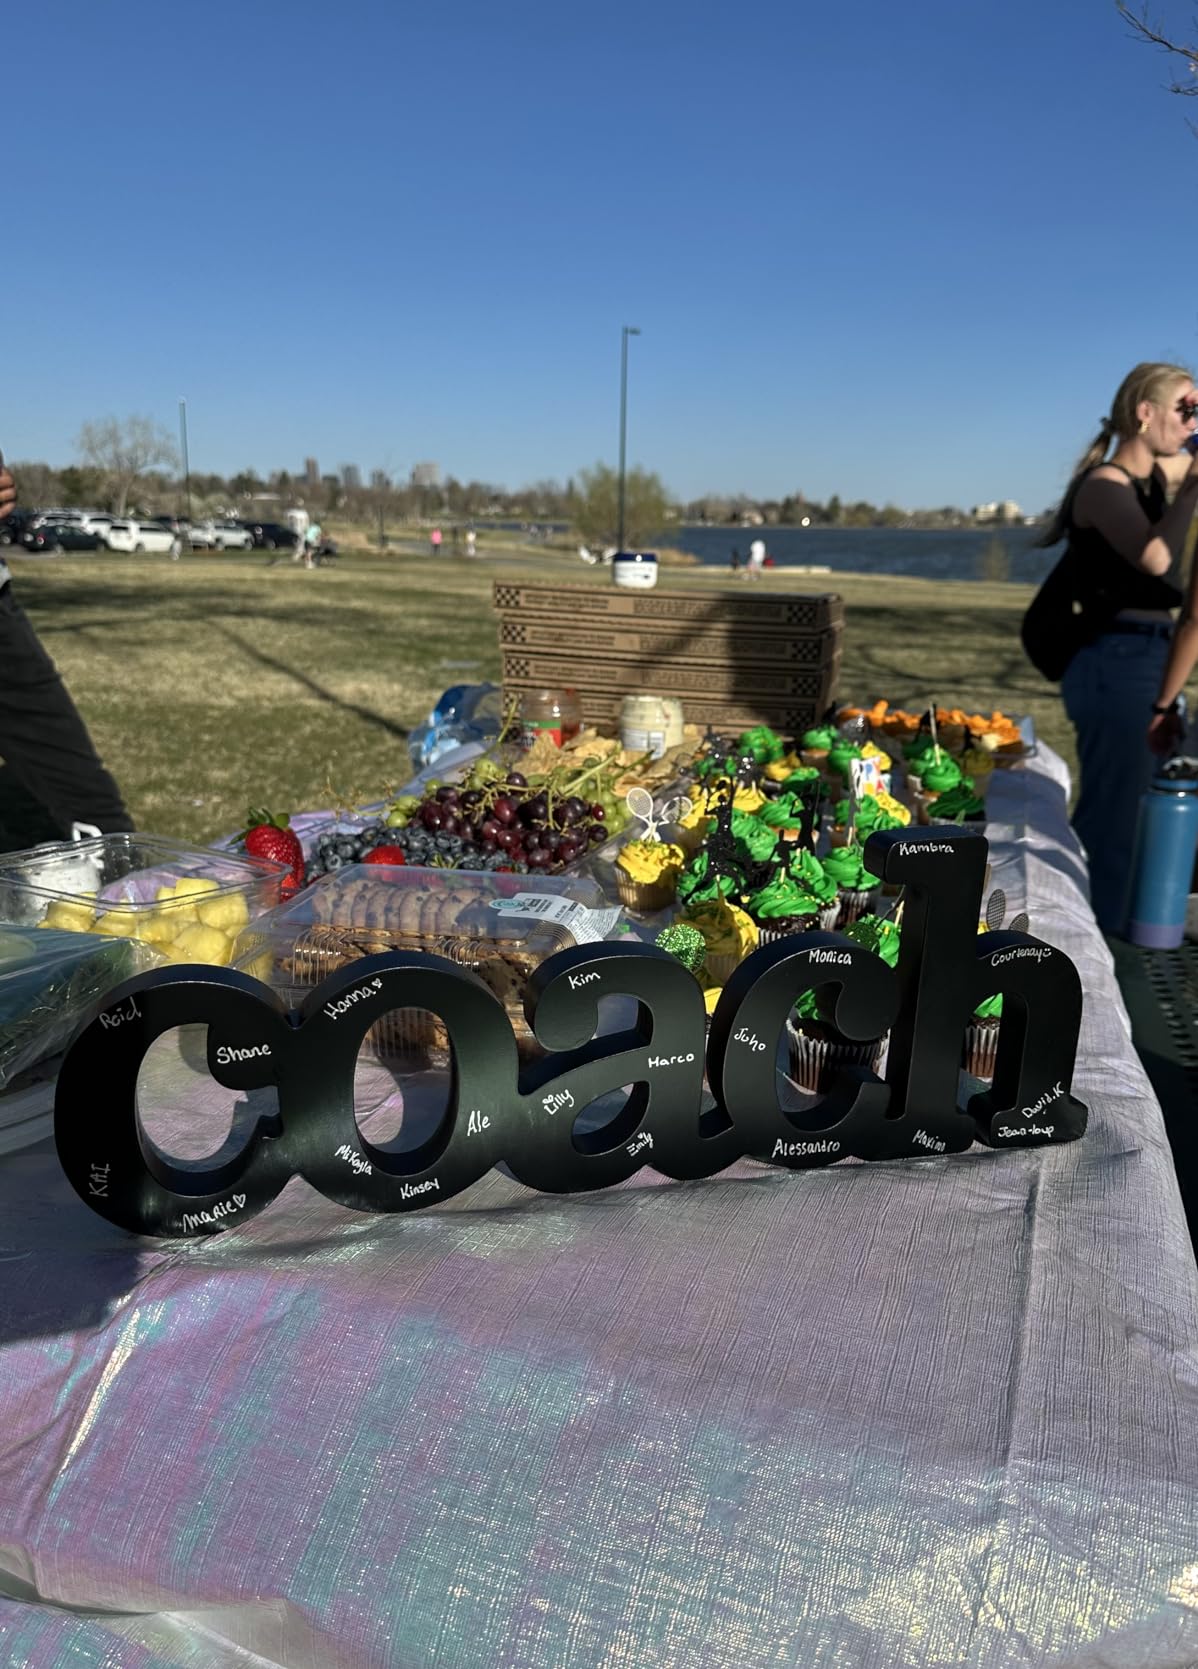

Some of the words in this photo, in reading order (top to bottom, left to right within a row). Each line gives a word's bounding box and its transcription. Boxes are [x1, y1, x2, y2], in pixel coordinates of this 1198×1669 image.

[808, 949, 852, 965] Monica
[568, 970, 601, 990] Kim
[98, 995, 142, 1029] Reid
[323, 986, 377, 1020] Hanna
[54, 825, 1089, 1238] coach
[216, 1043, 272, 1064] Shane
[466, 1110, 491, 1136] Ale
[771, 1138, 841, 1158] Alessandro
[400, 1178, 440, 1200] Kinsey
